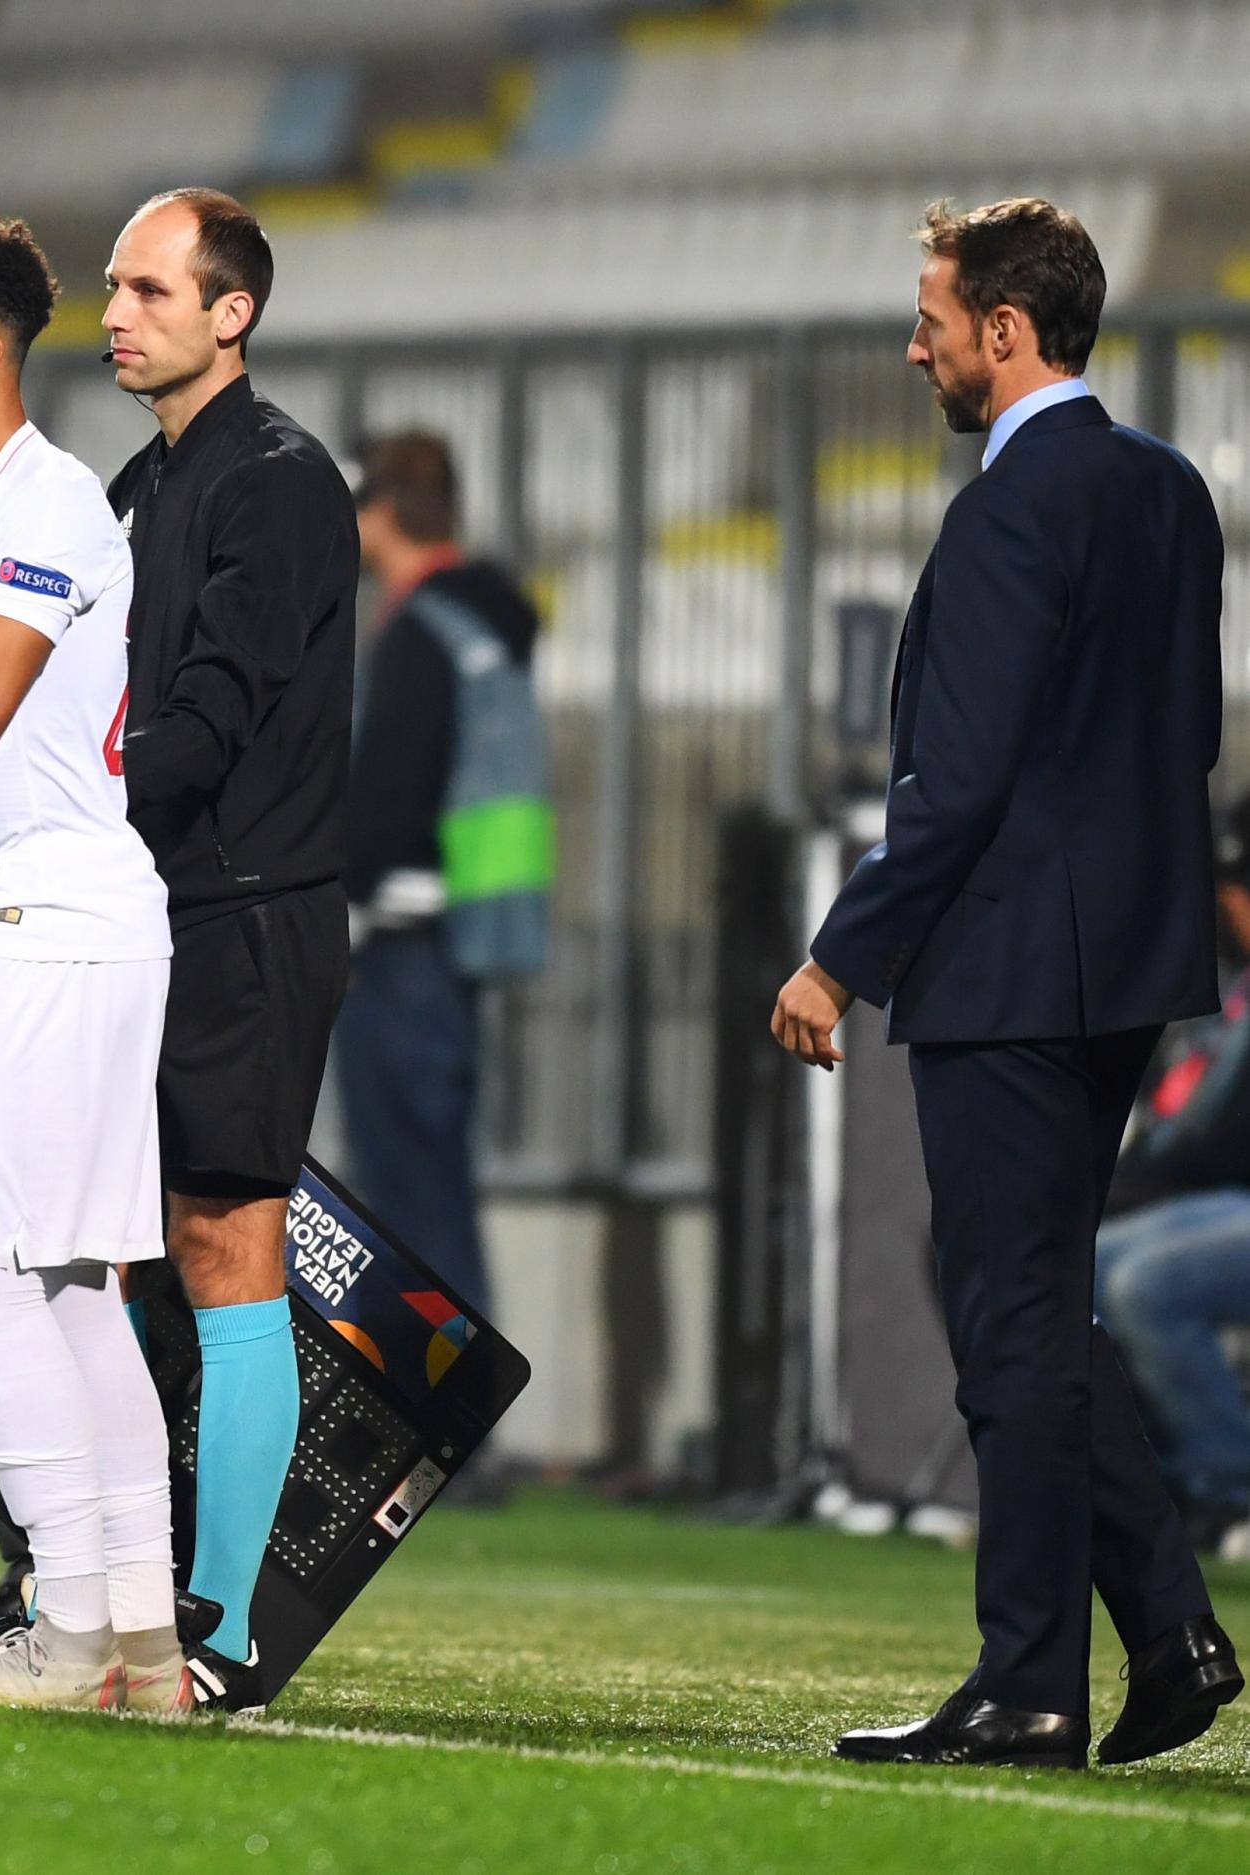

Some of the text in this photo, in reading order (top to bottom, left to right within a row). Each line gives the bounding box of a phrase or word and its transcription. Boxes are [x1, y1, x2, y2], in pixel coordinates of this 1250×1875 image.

[14, 568, 71, 596] RESPECT
[288, 1187, 375, 1272] LEAGUE
[294, 1247, 345, 1307] UEFA
